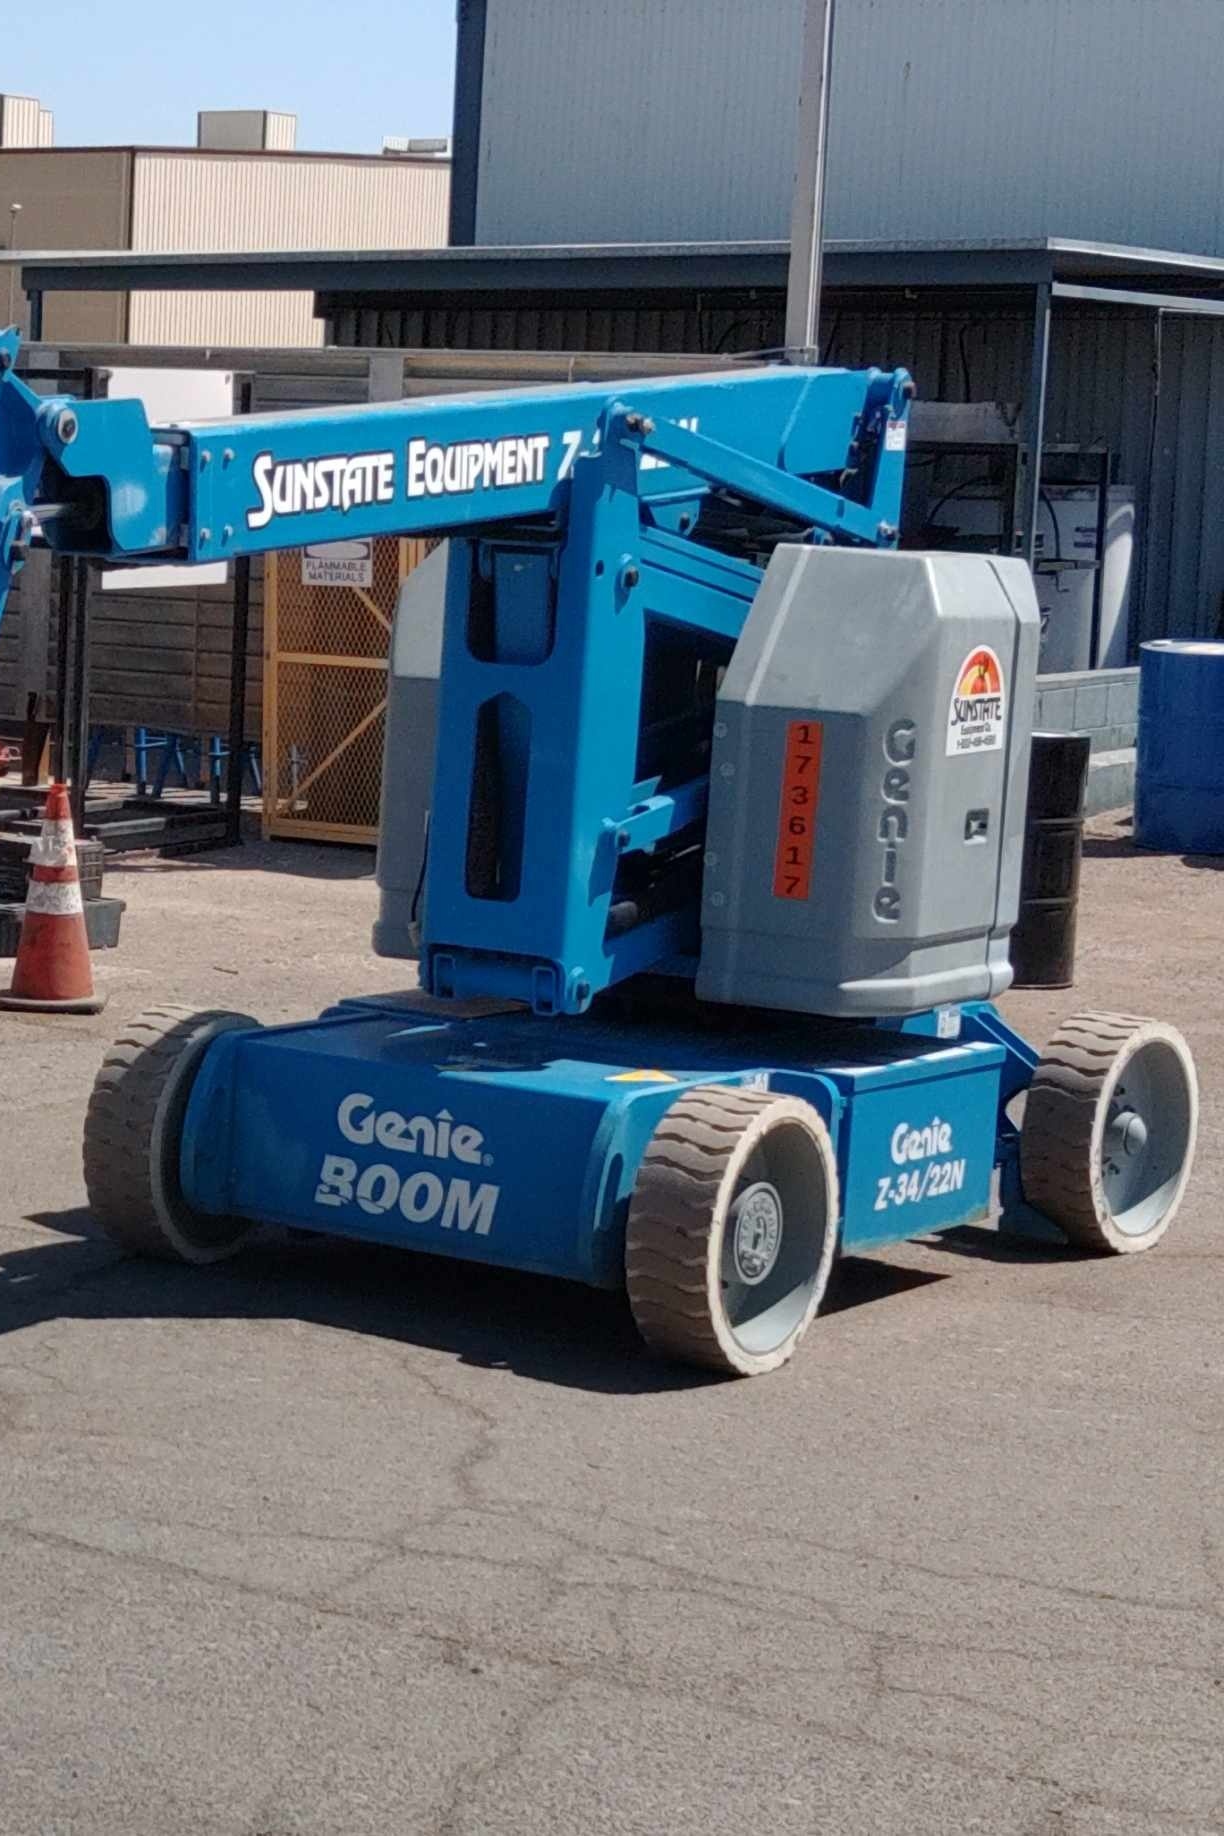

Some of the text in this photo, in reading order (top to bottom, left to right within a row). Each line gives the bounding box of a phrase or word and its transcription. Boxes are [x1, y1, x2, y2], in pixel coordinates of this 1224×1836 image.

[247, 451, 395, 529] SUNSTATE
[407, 431, 550, 497] EQUIPMENT
[305, 560, 367, 572] FLAMMABLE
[308, 570, 366, 582] MATERIALS
[950, 697, 1002, 726] SUNSTATE
[784, 724, 812, 896] 173617
[873, 718, 917, 923] Genie
[337, 1092, 484, 1165] Genie
[891, 1116, 953, 1165] Genie
[315, 1154, 500, 1235] BOOM
[874, 1159, 966, 1211] Z-34/22N
